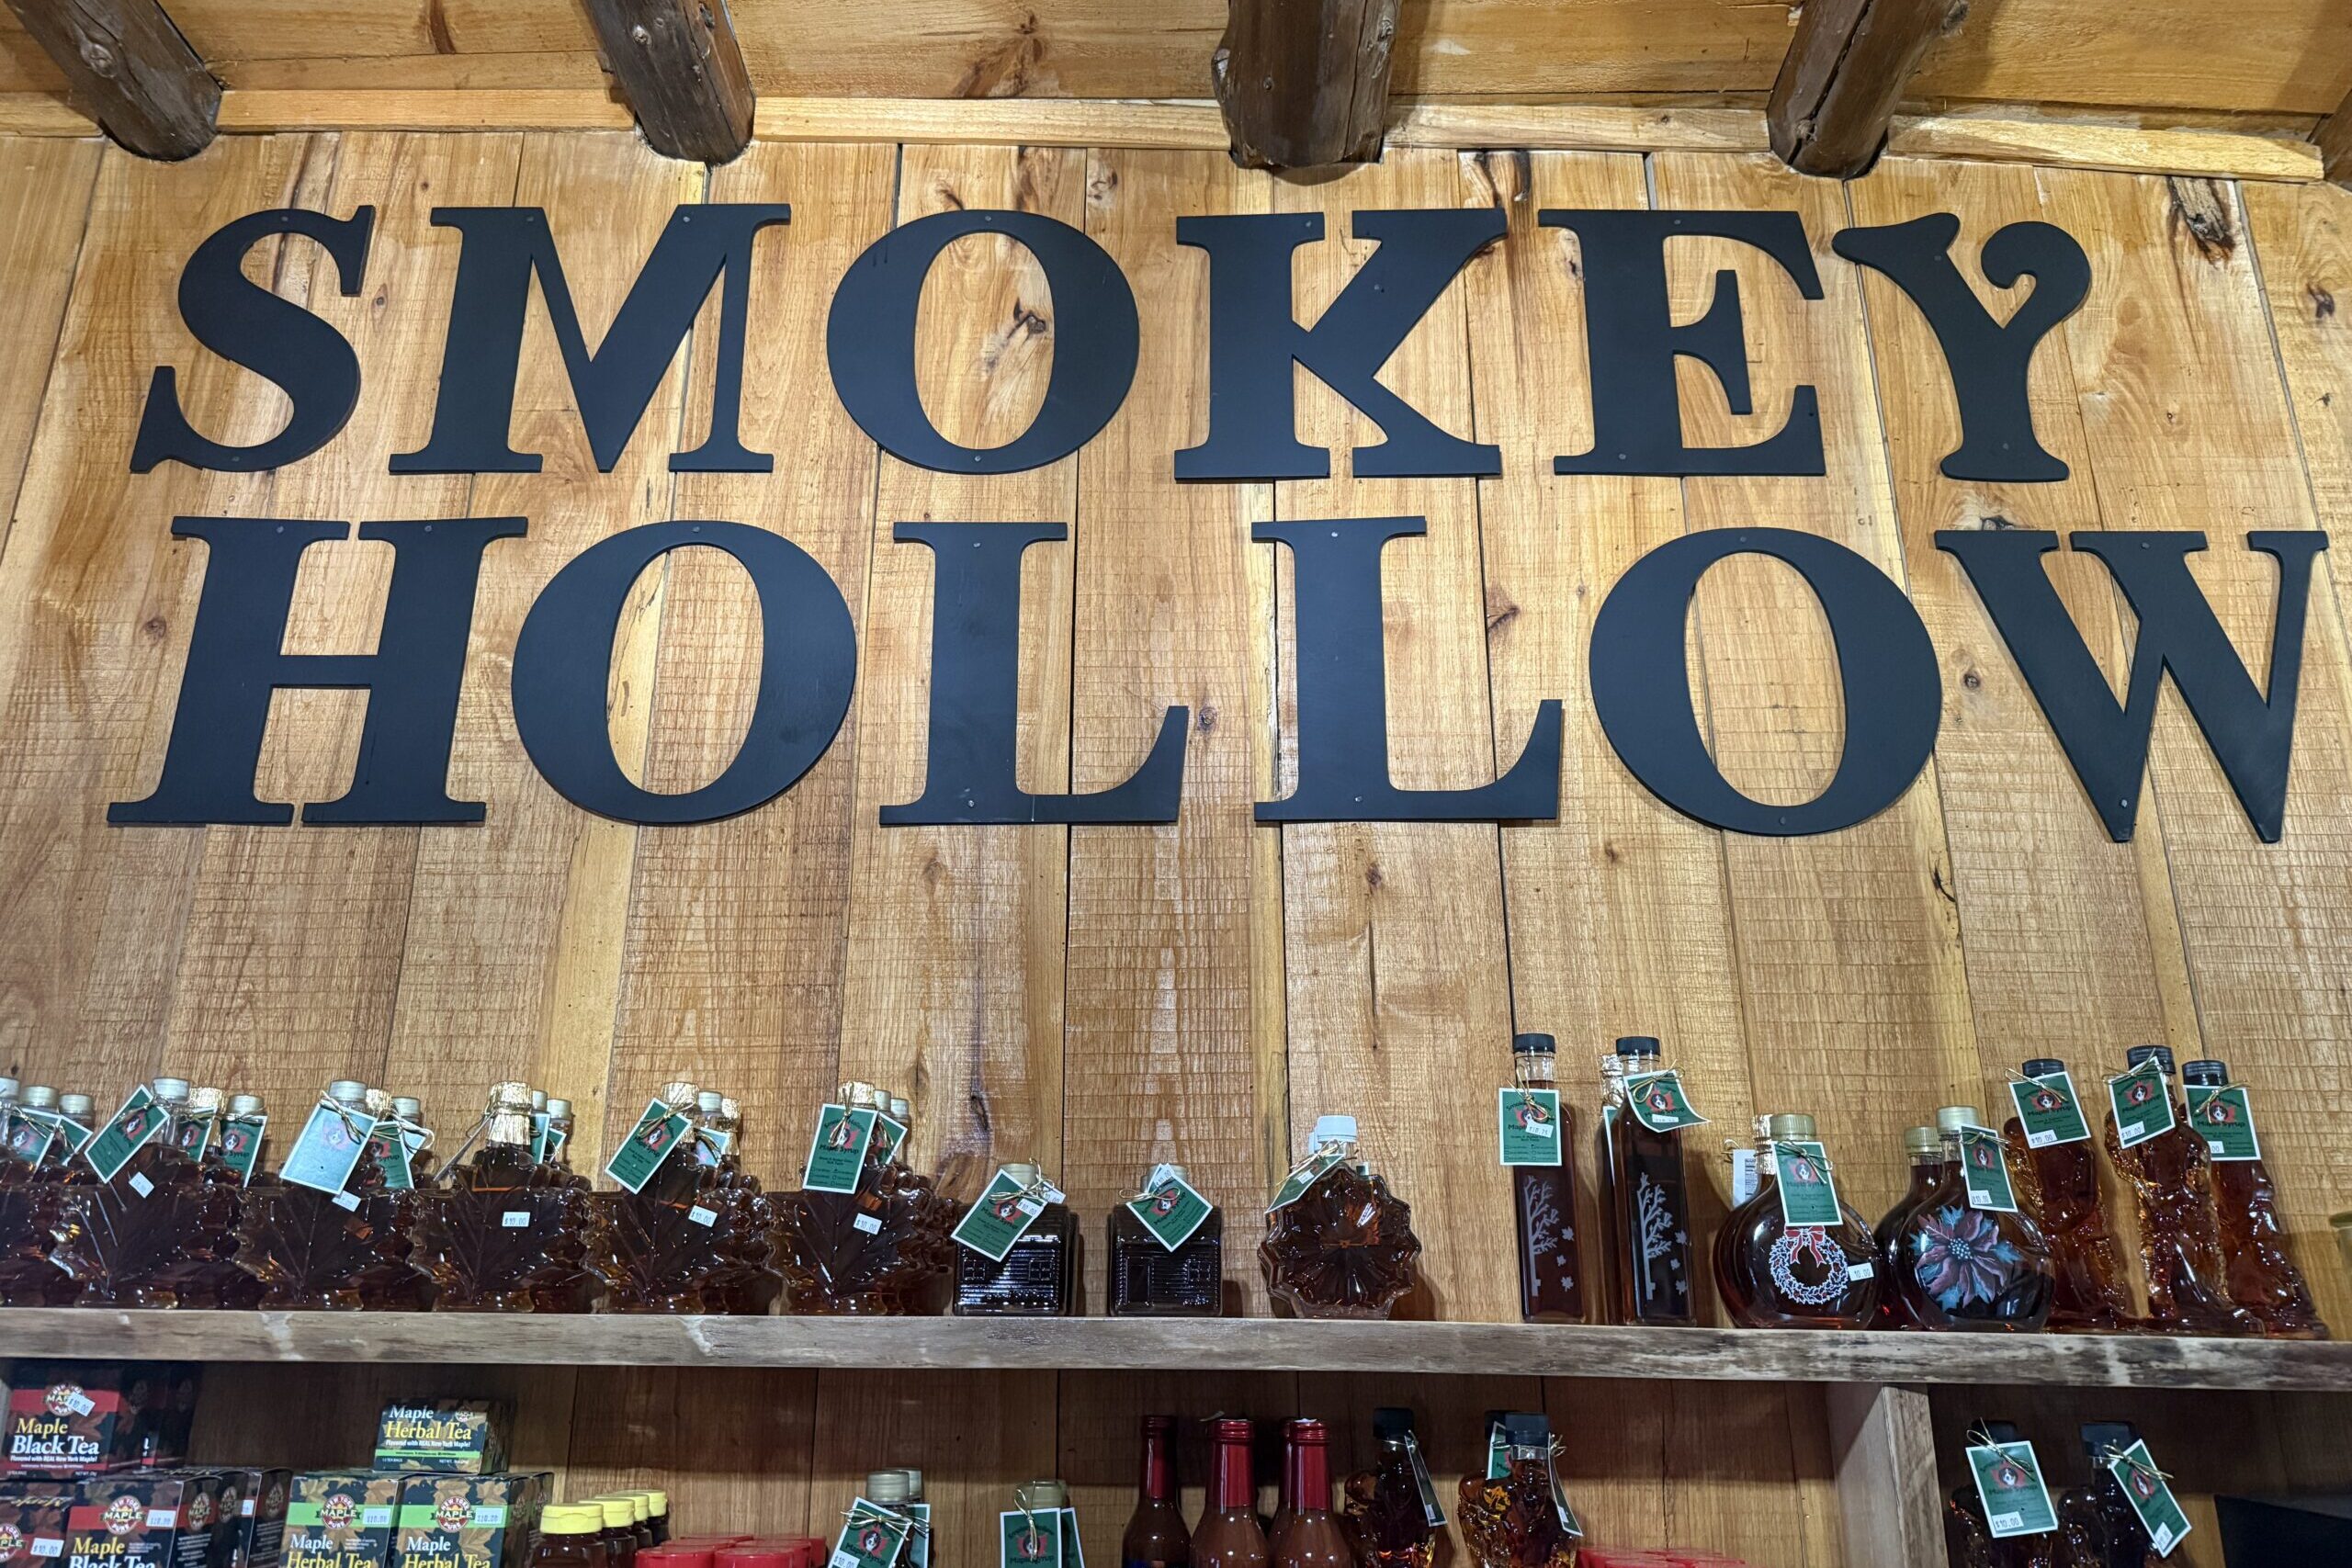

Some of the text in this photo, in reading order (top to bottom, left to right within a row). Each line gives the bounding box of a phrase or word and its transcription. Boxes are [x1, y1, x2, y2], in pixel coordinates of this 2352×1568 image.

[132, 194, 2090, 482] SMOKEY
[107, 516, 2328, 843] HOLLOW
[2031, 1134, 2053, 1145] $10.00
[2121, 1126, 2142, 1139] $10.00
[389, 1404, 435, 1423] Maple
[16, 1417, 69, 1439] Maple
[385, 1421, 472, 1440] Herbal Tea
[10, 1435, 100, 1455] Black Tea
[441, 1497, 454, 1511] NEW
[103, 1511, 144, 1520] MAPLE
[320, 1509, 357, 1517] MAPLE
[1995, 1517, 2019, 1529] $10.00
[33, 1544, 59, 1555] $10.00
[73, 1537, 126, 1560] Maple
[290, 1534, 334, 1554] Maple
[407, 1537, 451, 1556] Maple
[69, 1554, 155, 1568] Black Tea
[287, 1551, 372, 1568] Herbal Tea
[404, 1553, 492, 1568] Herbal Tea
